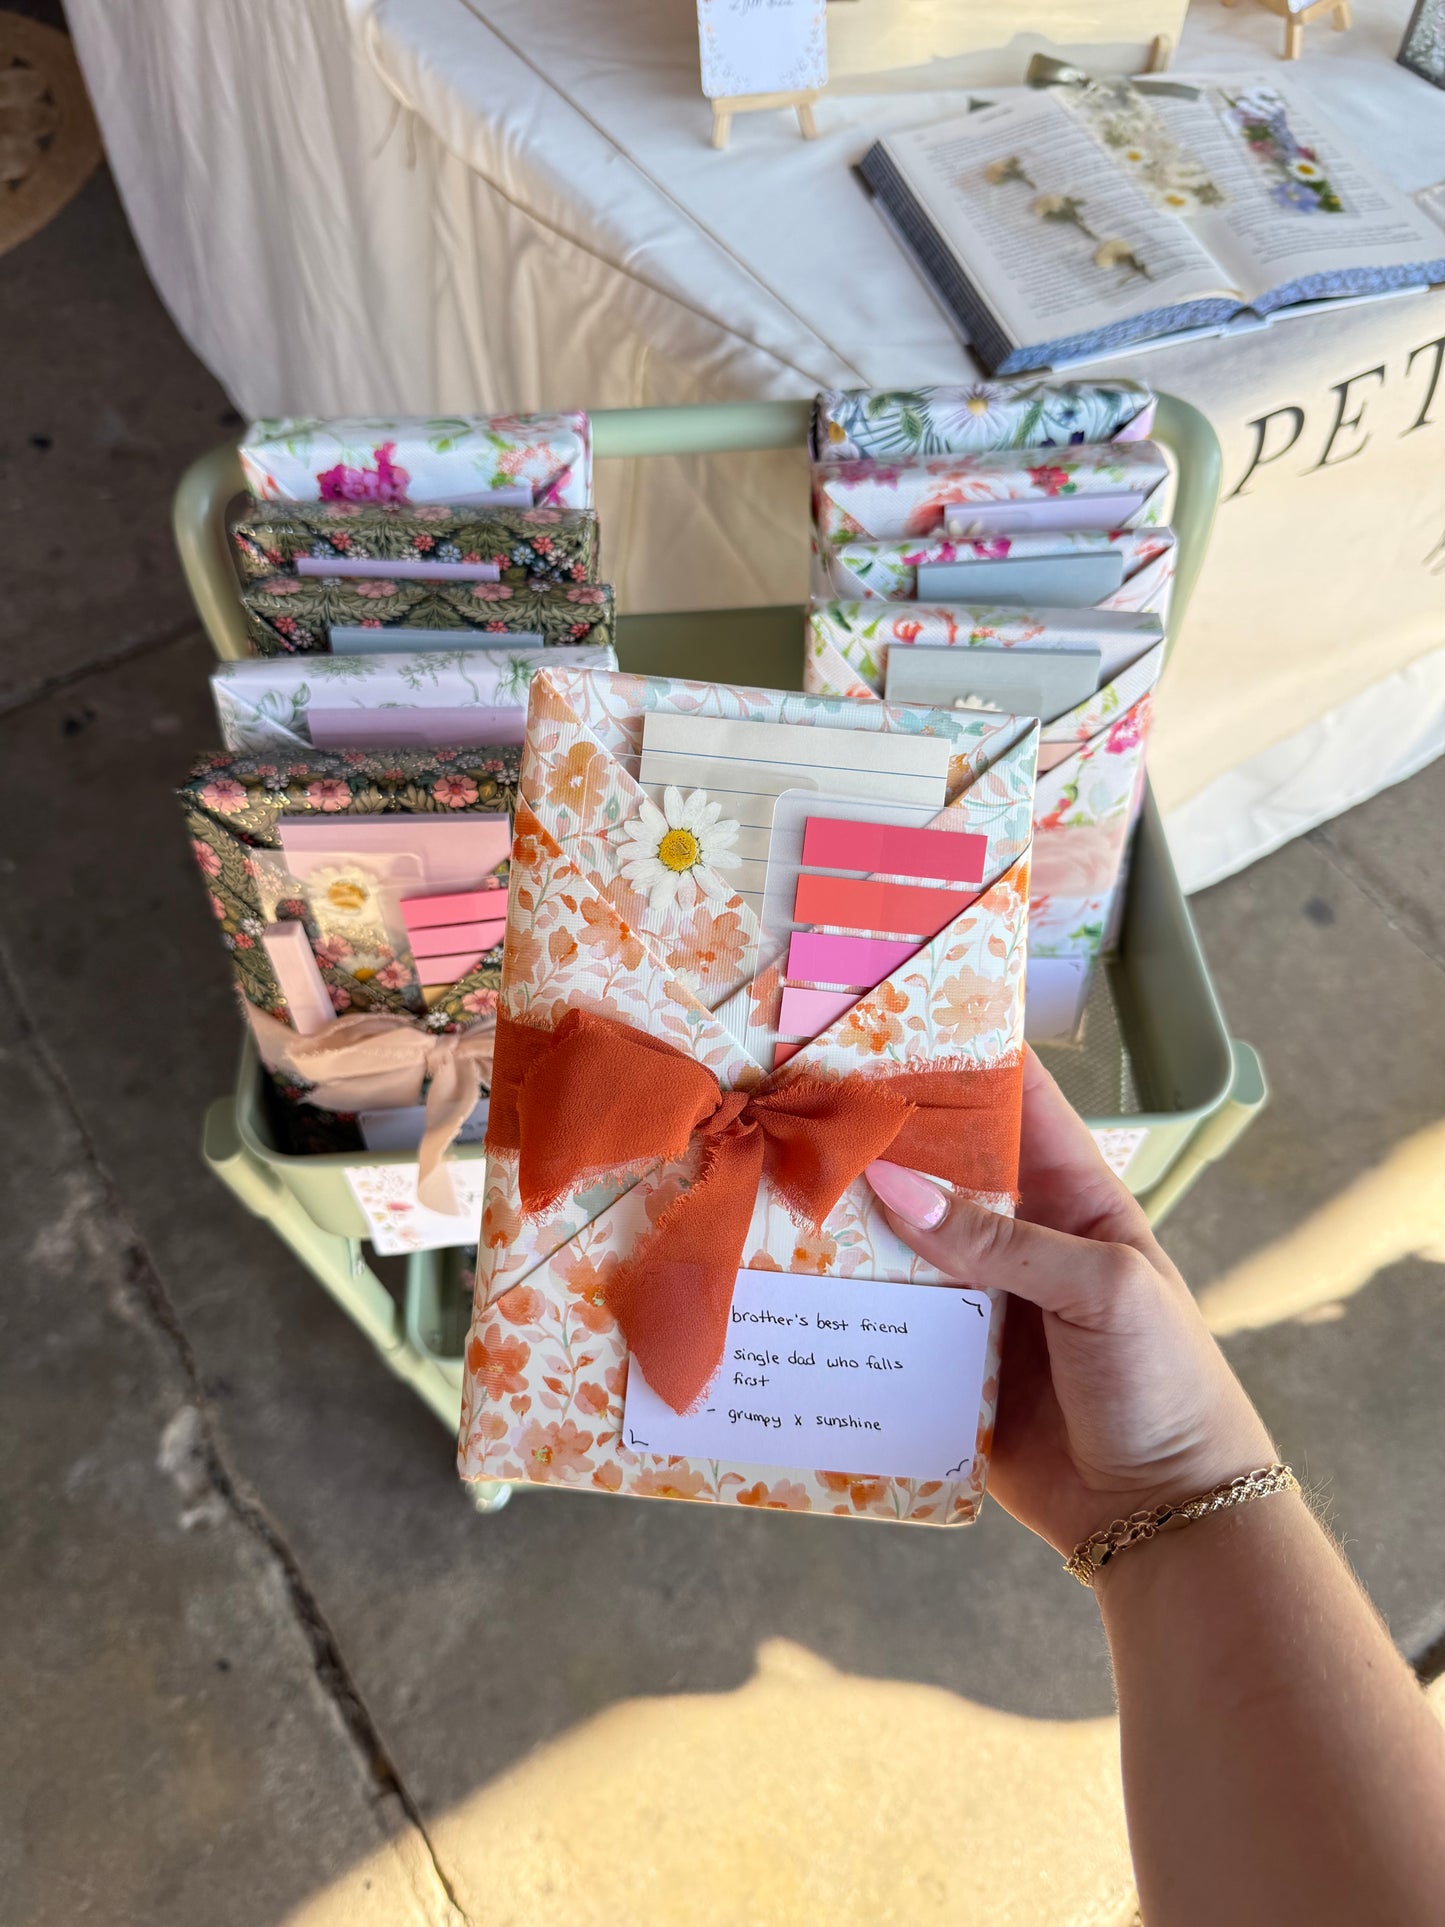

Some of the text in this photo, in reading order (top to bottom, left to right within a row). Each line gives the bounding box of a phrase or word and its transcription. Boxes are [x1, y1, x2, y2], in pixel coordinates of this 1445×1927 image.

[731, 1305, 909, 1334] brother's best friend
[733, 1348, 904, 1370] single dad who falls
[733, 1371, 770, 1387] first
[728, 1408, 782, 1428] grumpy
[816, 1414, 882, 1431] sunshine
